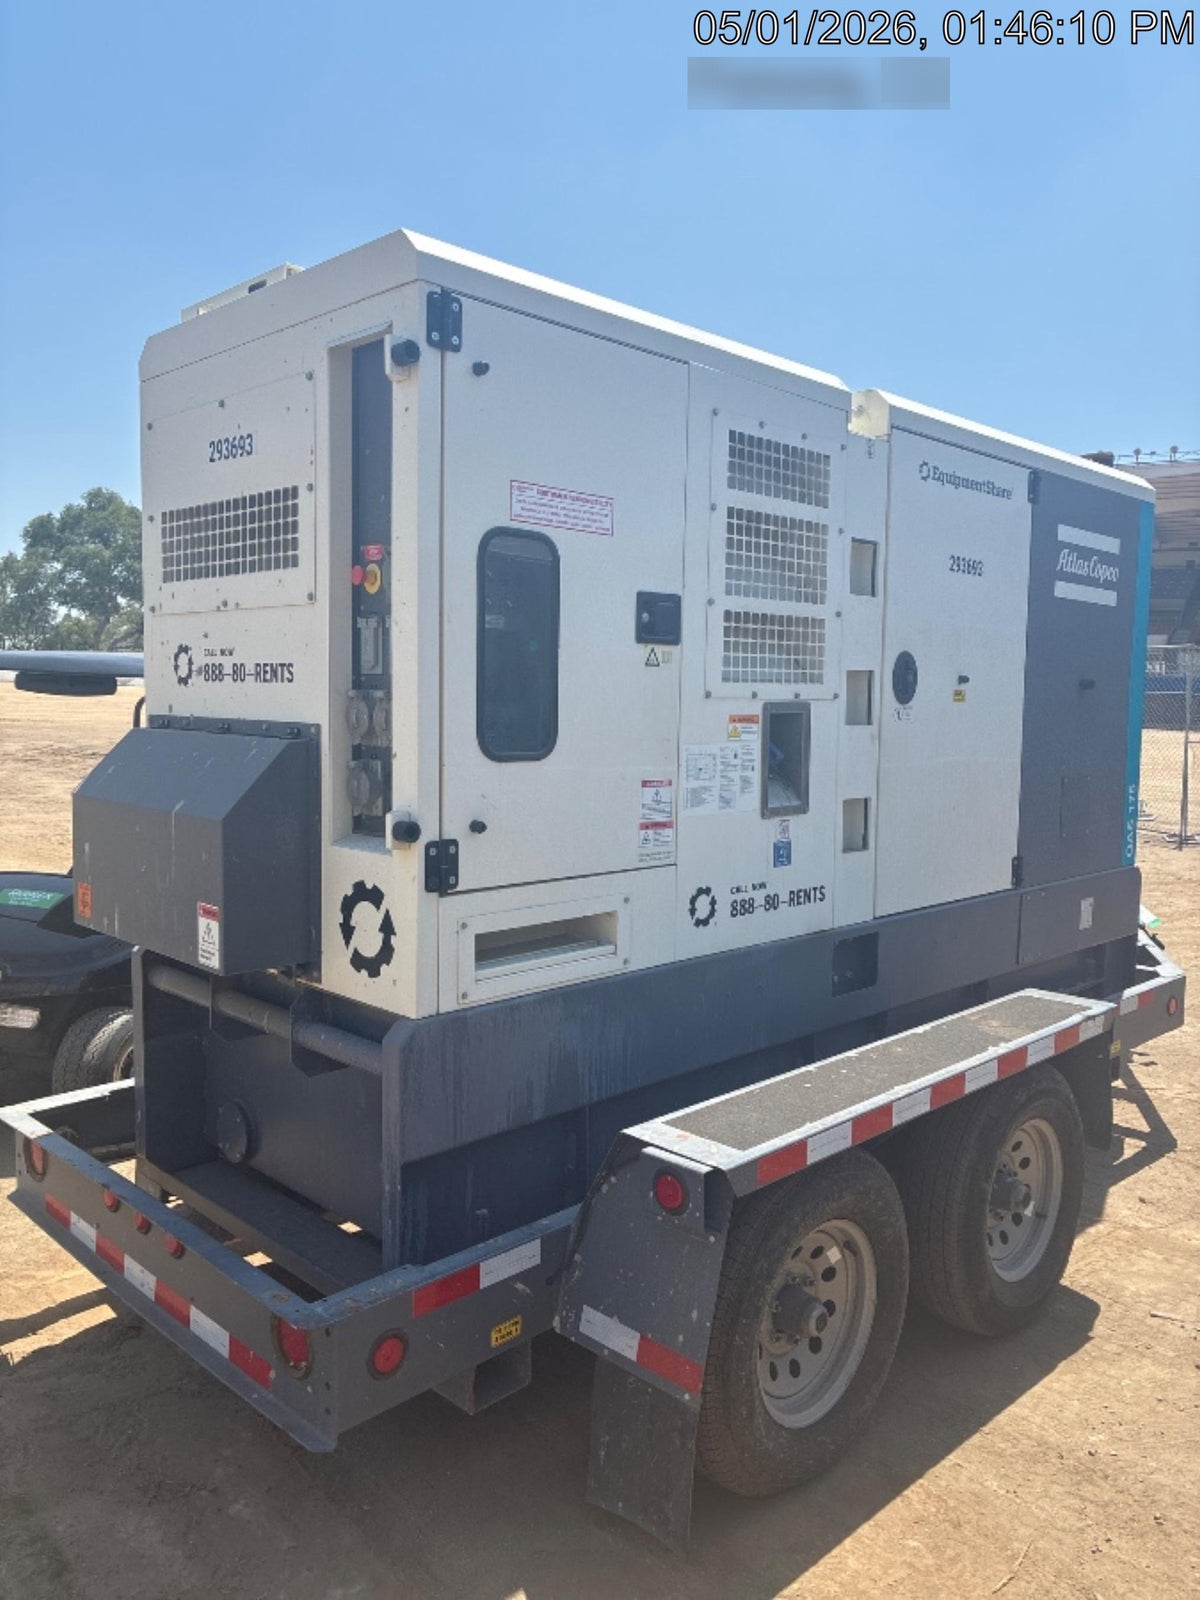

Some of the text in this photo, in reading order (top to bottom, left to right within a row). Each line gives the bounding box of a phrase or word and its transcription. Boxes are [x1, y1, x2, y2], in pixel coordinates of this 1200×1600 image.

[209, 433, 253, 463] 293693
[931, 465, 1013, 500] EquipmentShare
[949, 554, 984, 577] 293693
[1056, 548, 1120, 583] Atlas Copco
[203, 662, 294, 684] 888-80-RENTS
[730, 882, 767, 895] CALL NOW
[730, 885, 826, 918] 888-80-RENTS
